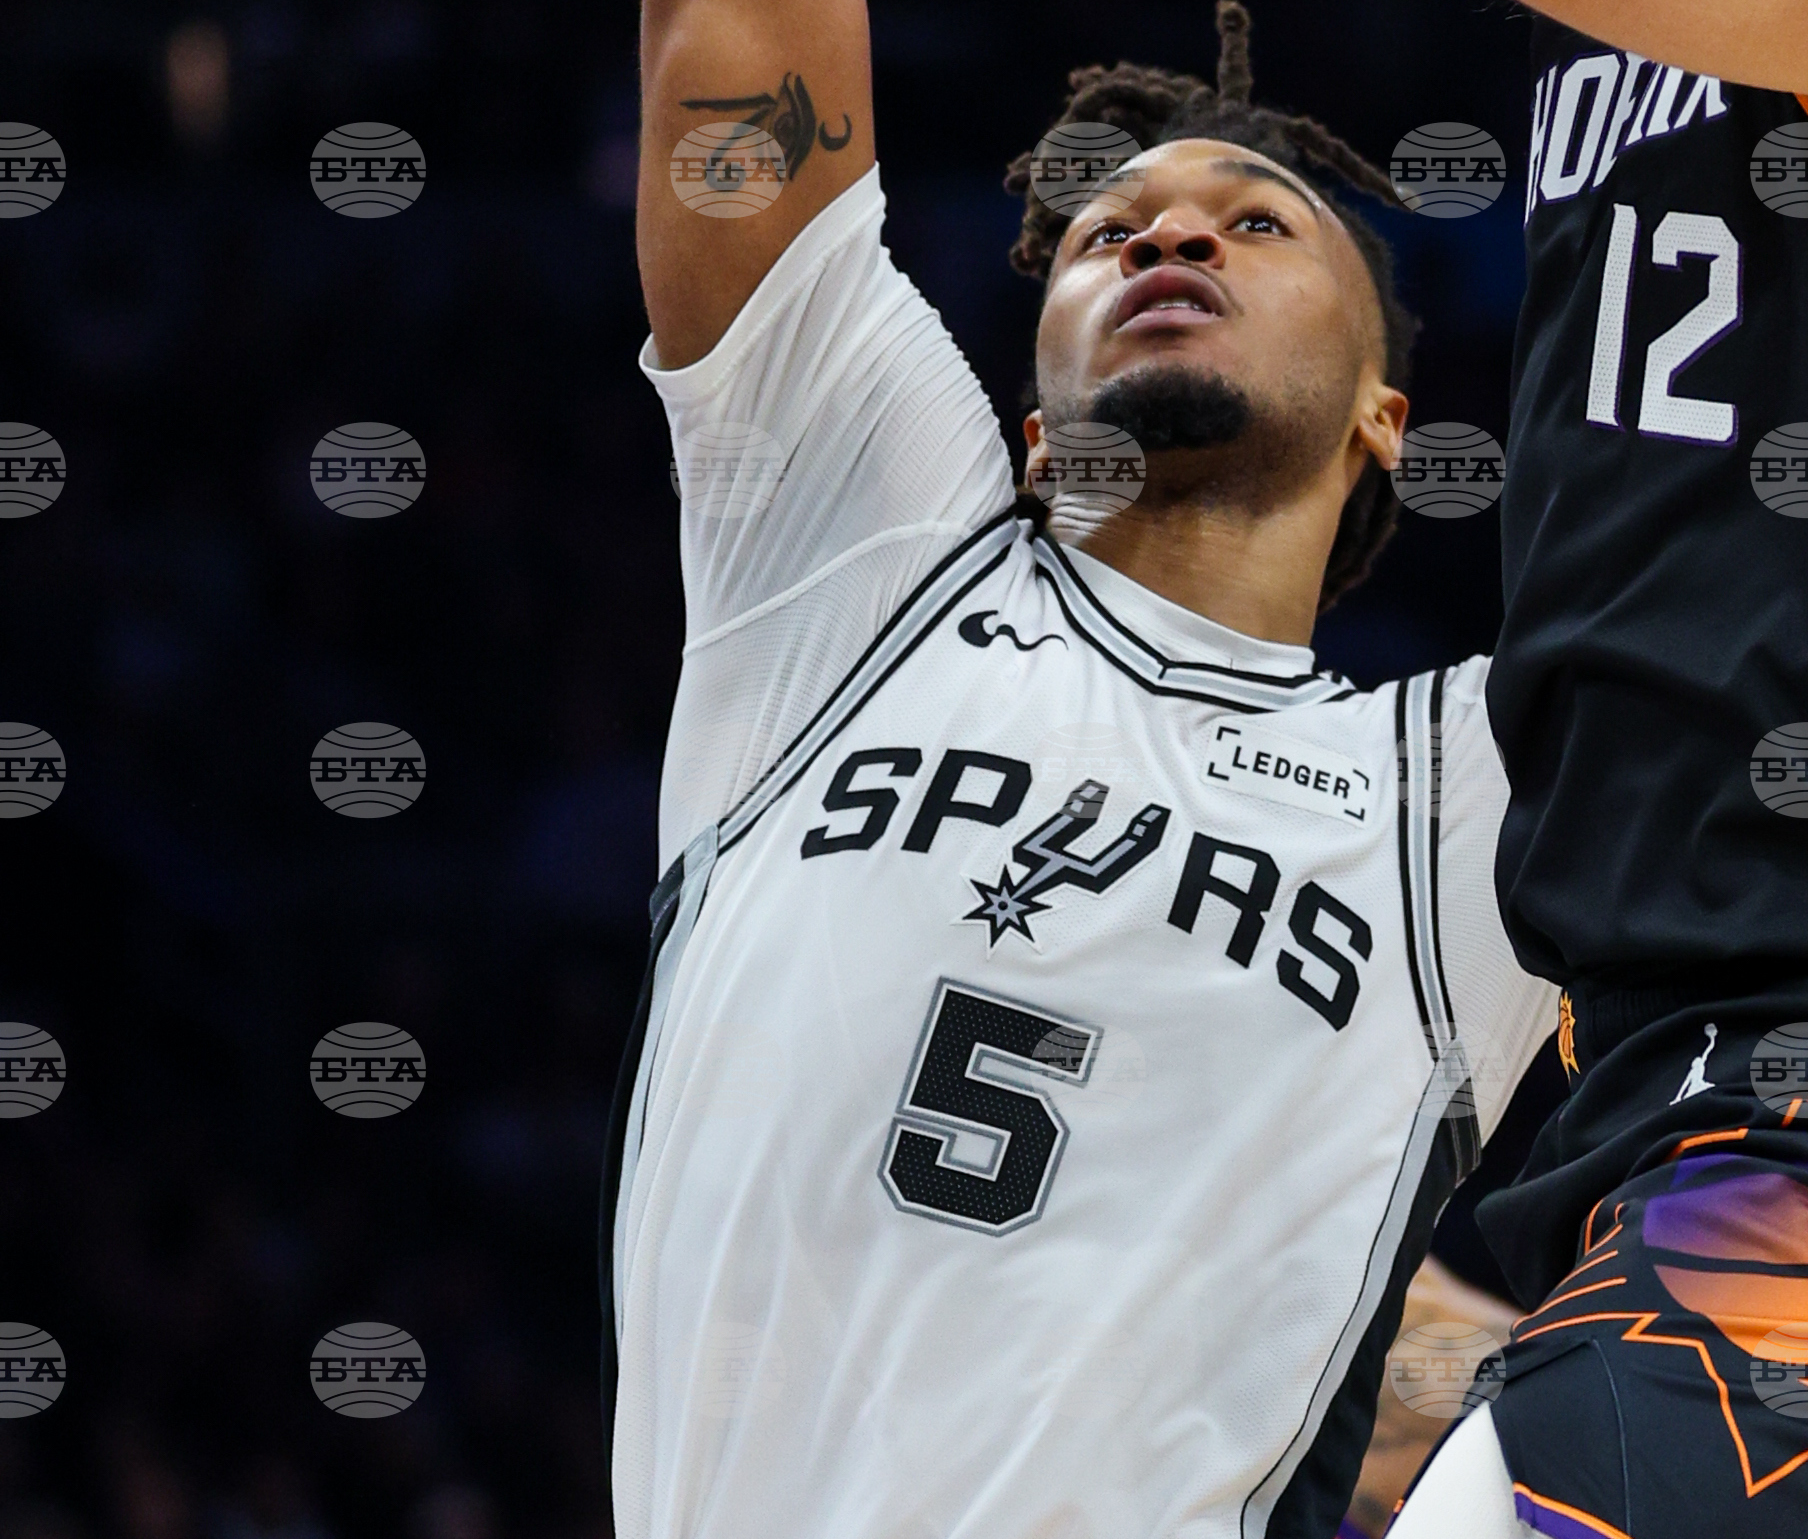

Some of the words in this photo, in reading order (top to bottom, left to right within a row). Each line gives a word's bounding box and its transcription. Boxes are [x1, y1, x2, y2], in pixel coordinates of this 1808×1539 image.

[1586, 202, 1742, 448] 12
[801, 746, 1373, 1032] SPURS
[1231, 745, 1352, 801] LEDGER
[876, 974, 1105, 1238] 5
